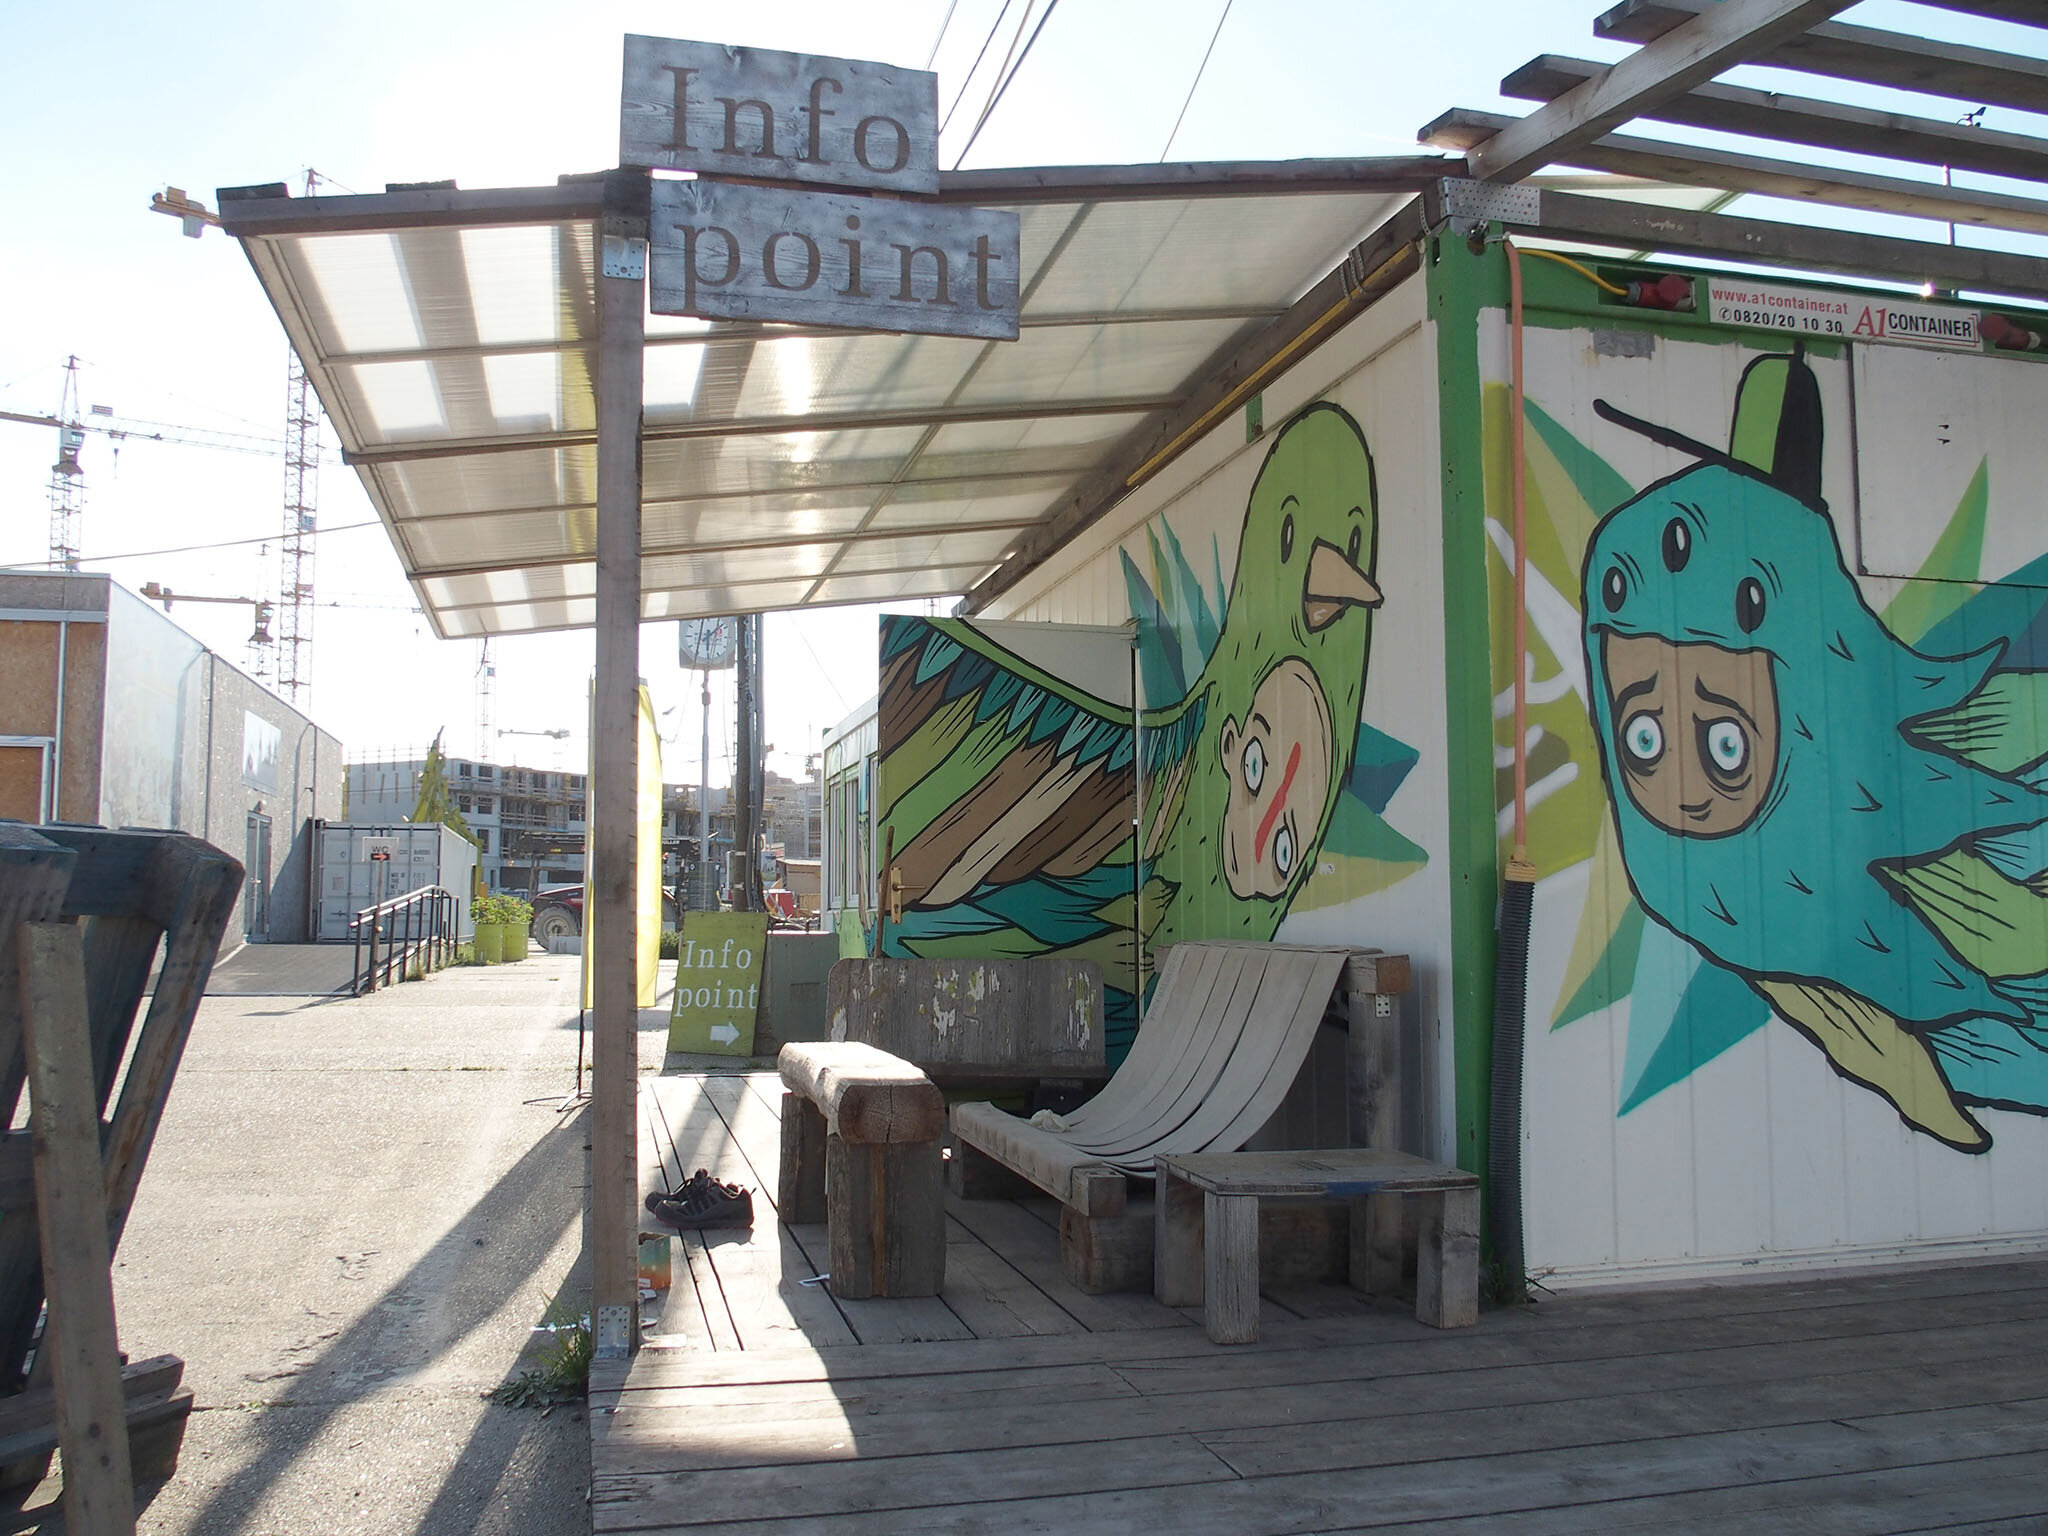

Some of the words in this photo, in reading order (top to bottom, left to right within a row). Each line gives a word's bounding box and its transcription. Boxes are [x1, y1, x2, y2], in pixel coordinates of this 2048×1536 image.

[661, 64, 910, 175] Info
[673, 213, 1004, 316] point
[1711, 289, 1849, 315] www.a1container.at
[1733, 309, 1796, 328] 0820/20
[1802, 317, 1819, 331] 10
[1825, 319, 1843, 333] 30
[1851, 305, 1889, 338] A1
[1888, 312, 1972, 338] CONTAINER
[372, 846, 389, 854] WC
[683, 938, 753, 969] Info
[674, 979, 758, 1017] point
